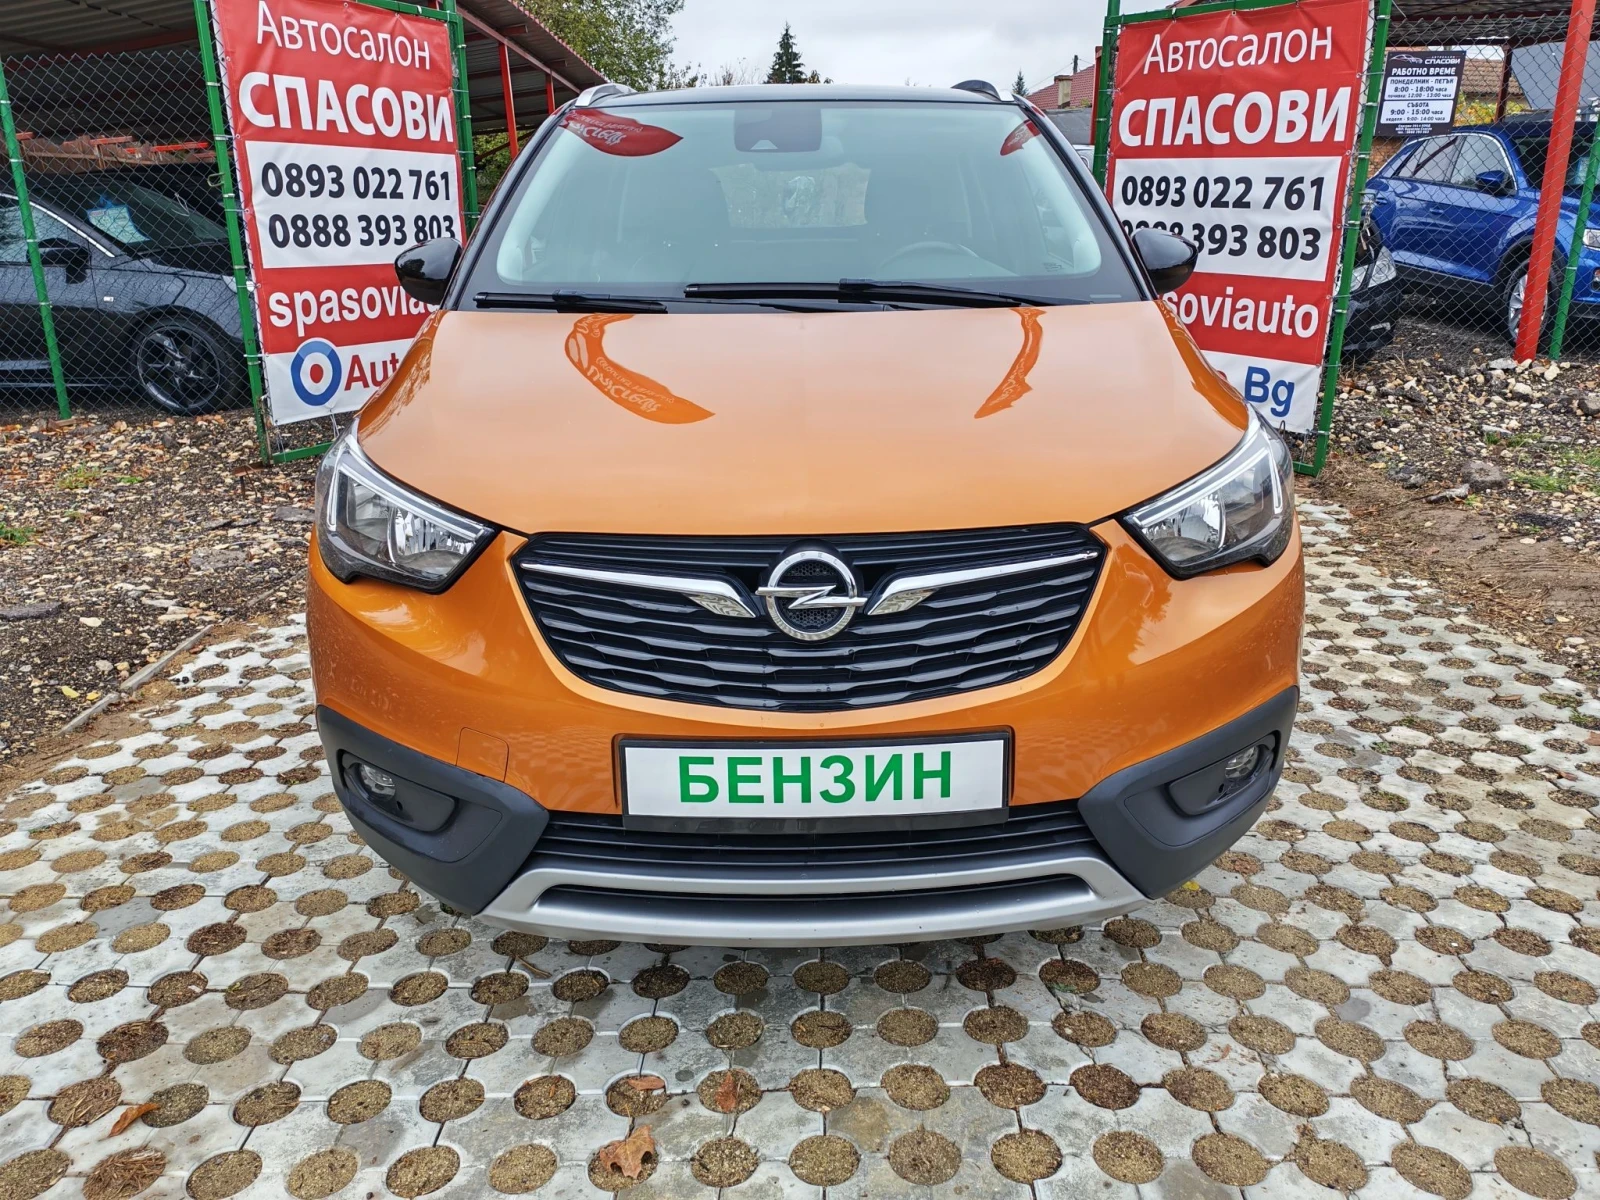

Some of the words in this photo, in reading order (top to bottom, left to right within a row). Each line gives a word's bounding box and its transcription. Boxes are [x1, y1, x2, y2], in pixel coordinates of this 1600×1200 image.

[256, 0, 430, 70] Автосалон
[1143, 26, 1332, 75] Автосалон
[238, 72, 454, 142] СПАСОВИ
[1118, 86, 1352, 147] СПАСОВИ
[261, 161, 345, 198] 0893
[353, 166, 404, 200] 022
[408, 169, 451, 201] 761
[1121, 175, 1187, 207] 0893
[1193, 176, 1254, 209] 022
[1262, 176, 1325, 211] 761
[268, 213, 352, 249] 0888
[357, 214, 408, 247] 393
[413, 214, 456, 244] 803
[1192, 222, 1249, 257] 393
[1257, 225, 1322, 261] 803
[1244, 365, 1295, 418] Bg
[784, 552, 839, 566] OPEL
[678, 750, 952, 804] БЕНЗИН
